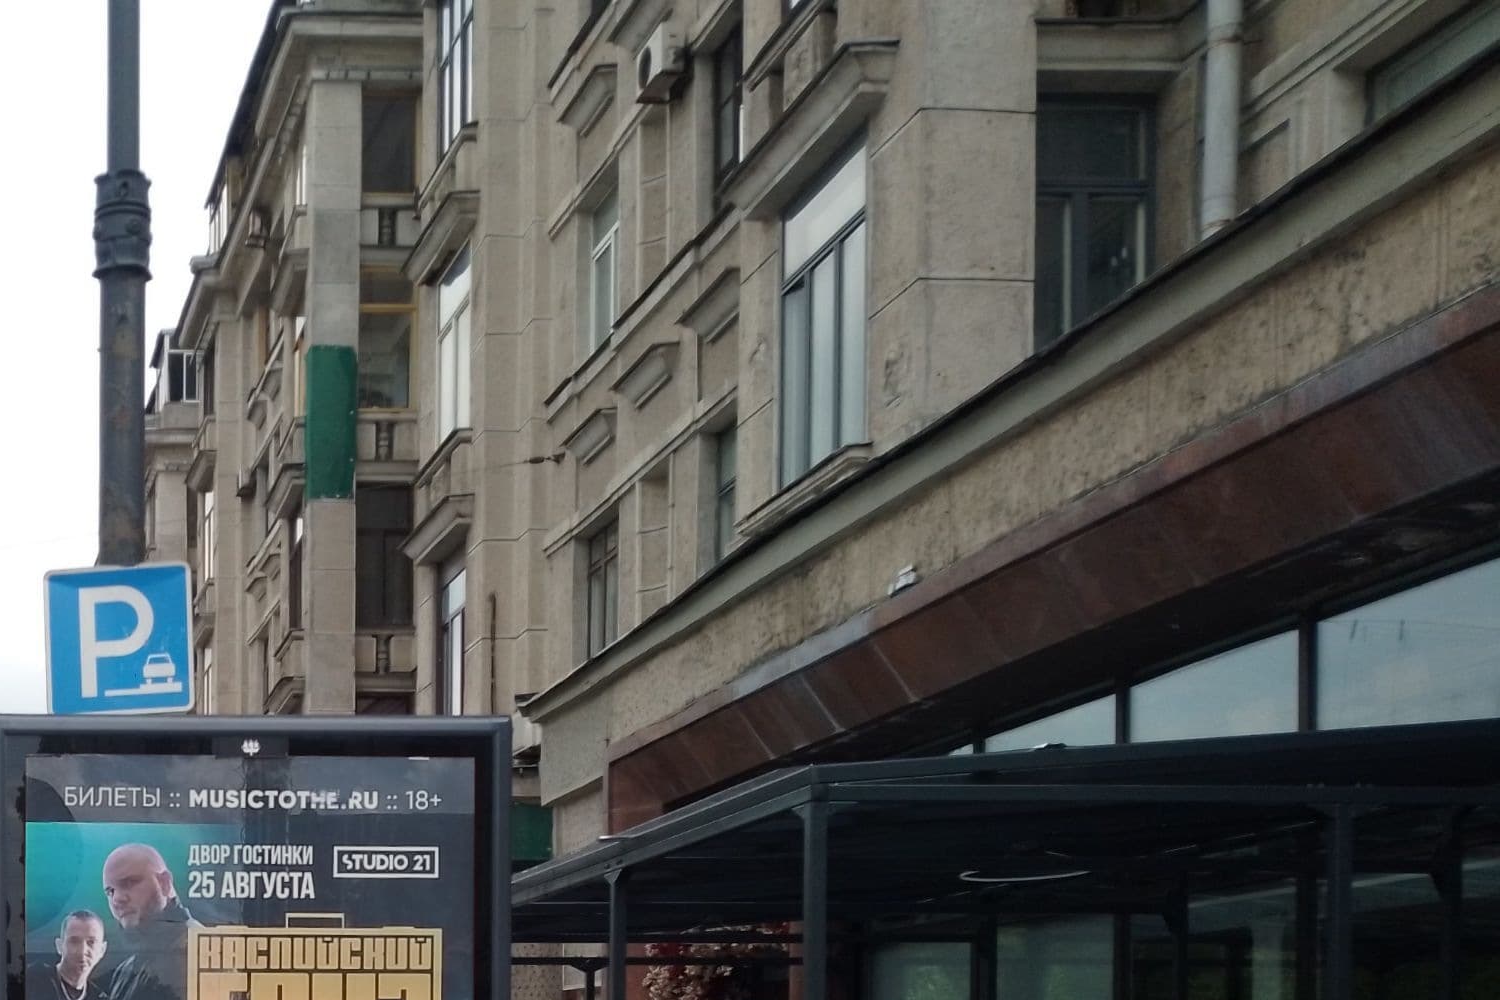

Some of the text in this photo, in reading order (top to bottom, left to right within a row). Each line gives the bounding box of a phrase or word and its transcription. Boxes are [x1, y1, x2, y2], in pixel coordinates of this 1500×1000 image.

[78, 585, 154, 698] P
[64, 786, 161, 808] БИЛЕТЫ
[189, 789, 379, 810] MUSICTOTHE.RU
[405, 790, 442, 810] 18+
[188, 845, 314, 866] ДВОР ГОСТИНКИ
[342, 854, 431, 871] STUDIO 21
[188, 871, 316, 899] 25 АВГУСТА
[199, 936, 433, 970] КАСПИЙСКИЙ
